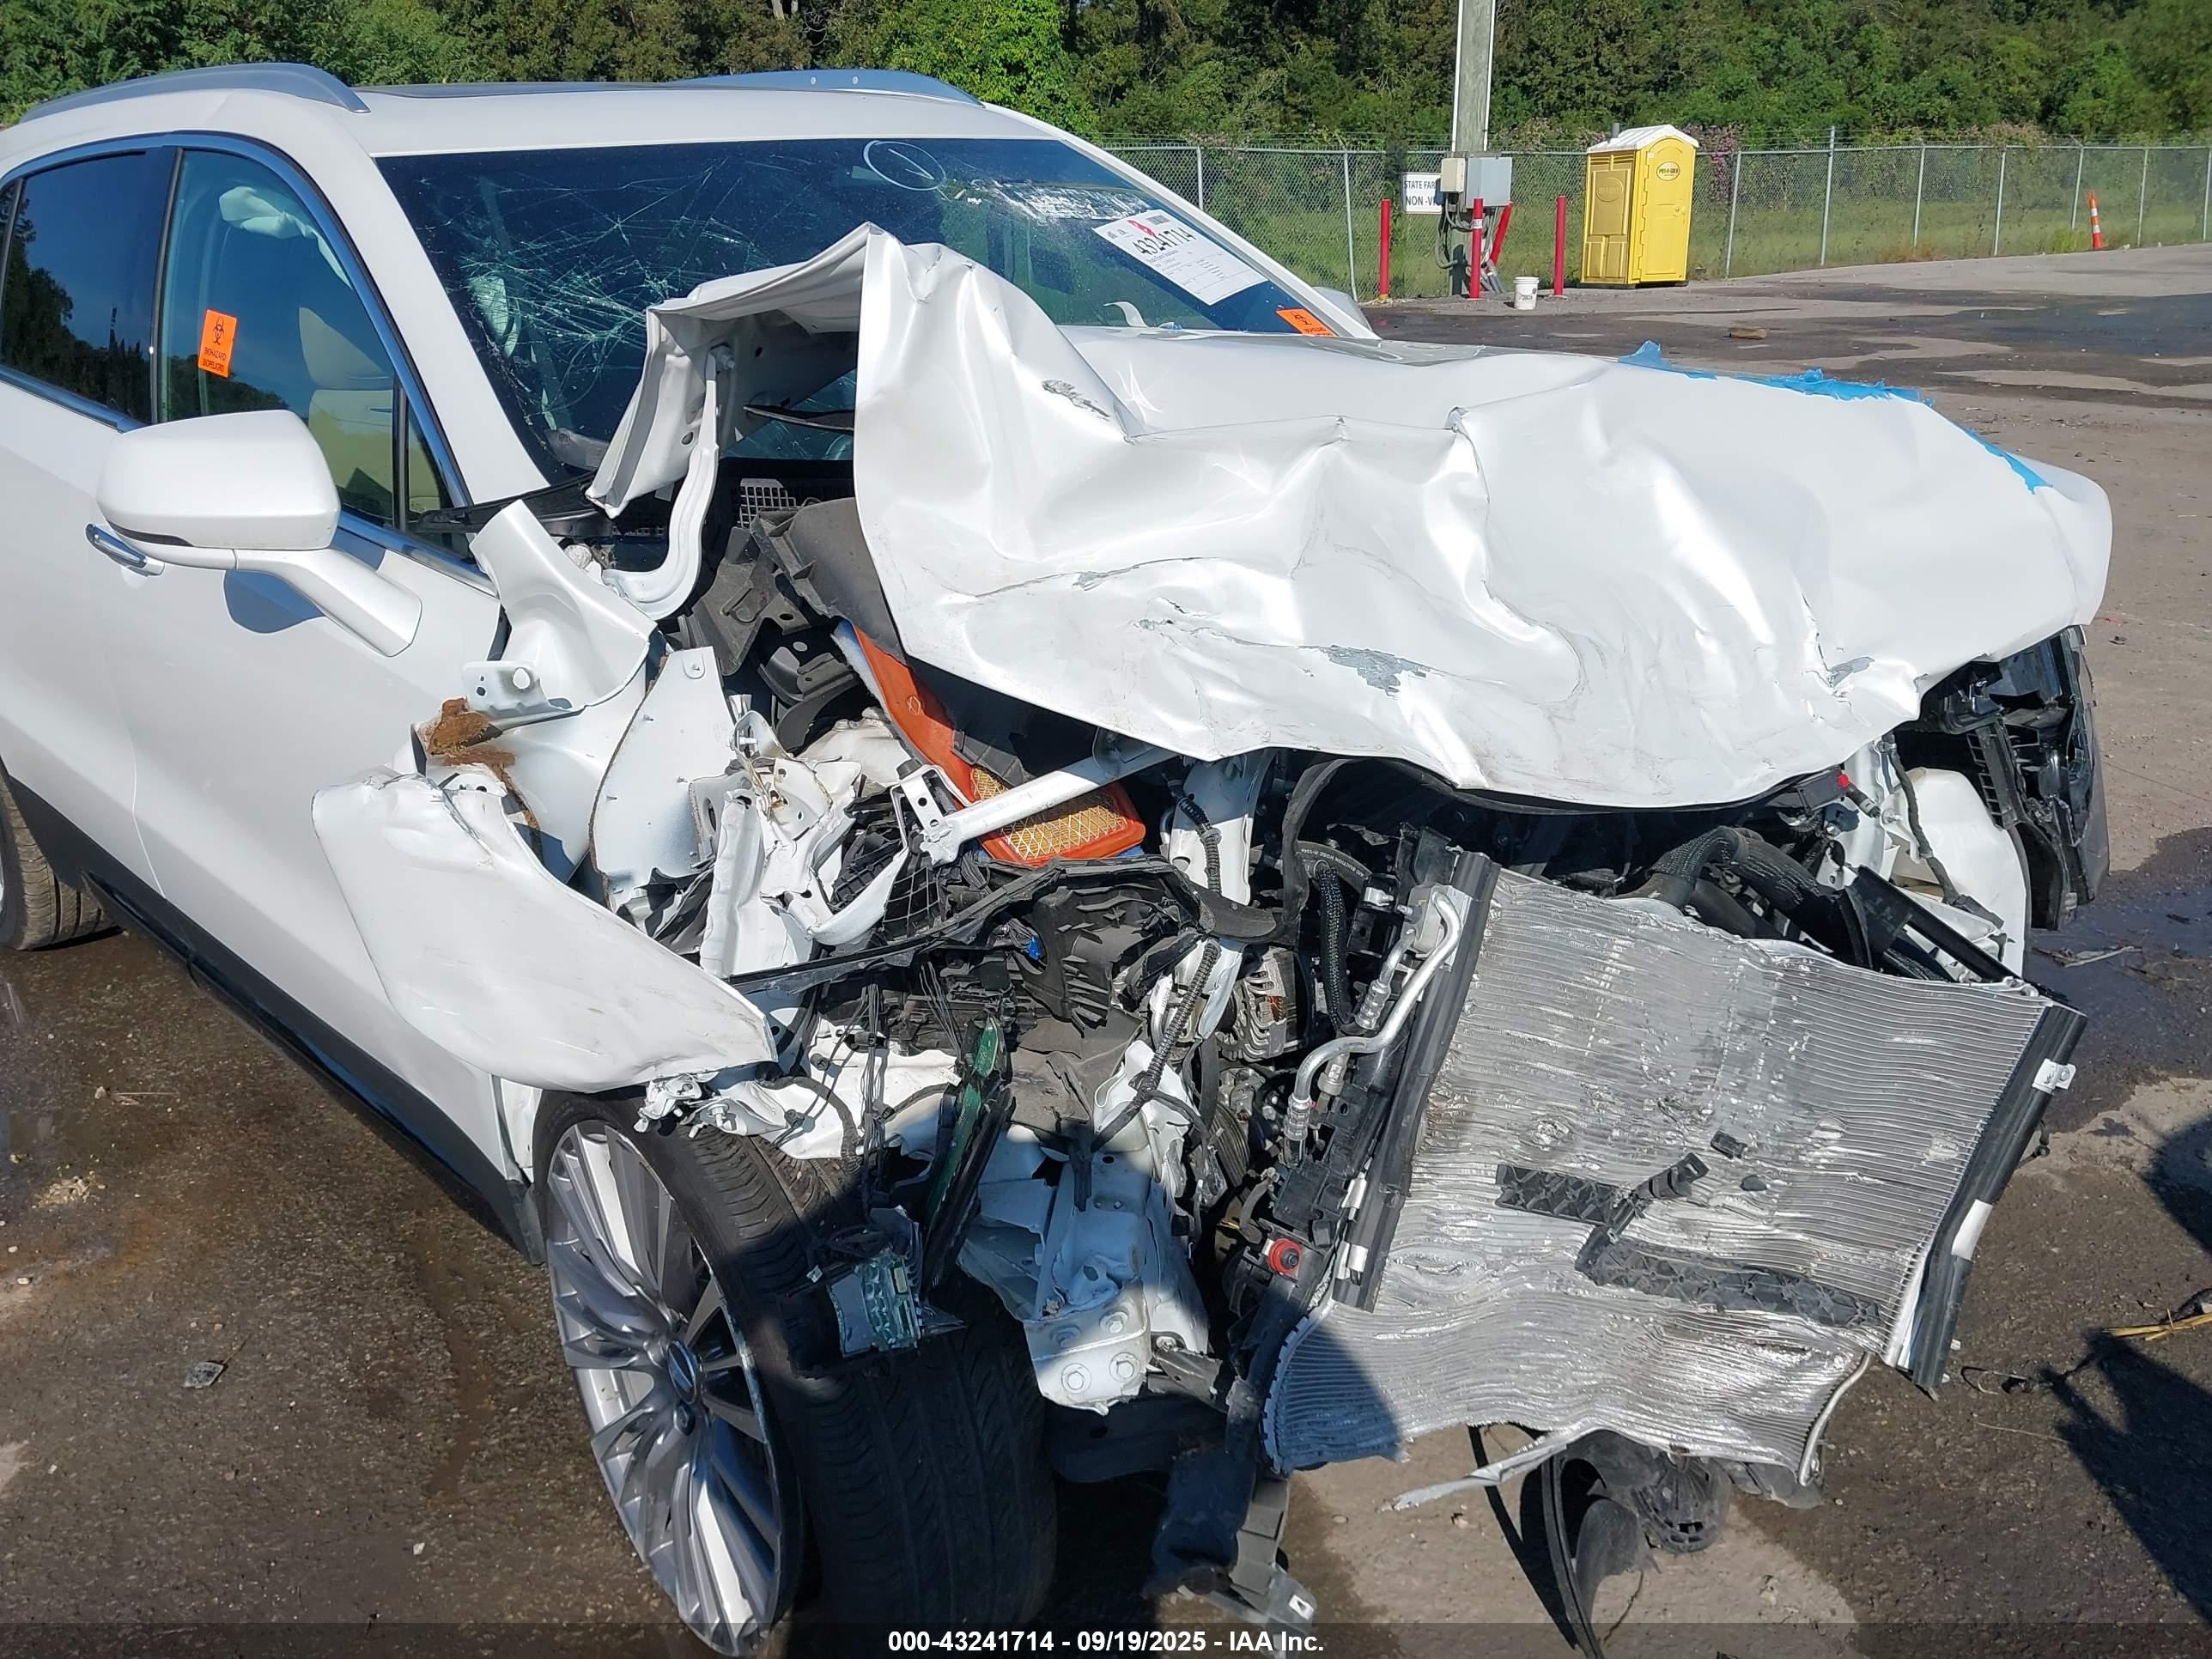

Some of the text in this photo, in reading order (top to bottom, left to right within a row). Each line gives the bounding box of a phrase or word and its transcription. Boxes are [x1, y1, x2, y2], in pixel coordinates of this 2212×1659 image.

[1404, 180, 1436, 190] STATE FAR
[1406, 196, 1424, 206] NON
[1132, 227, 1197, 256] 43241714
[204, 347, 227, 361] BIOHAZARD
[1319, 851, 1335, 860] HOSE
